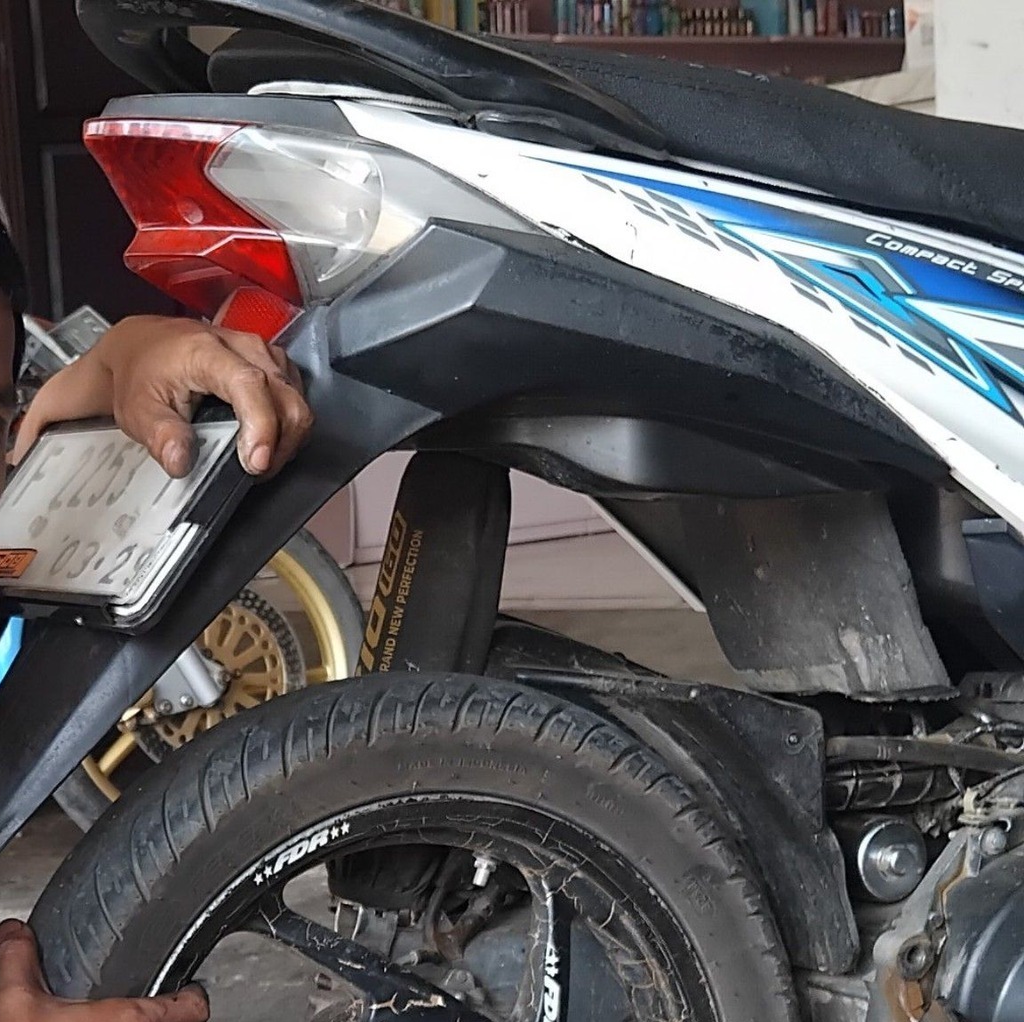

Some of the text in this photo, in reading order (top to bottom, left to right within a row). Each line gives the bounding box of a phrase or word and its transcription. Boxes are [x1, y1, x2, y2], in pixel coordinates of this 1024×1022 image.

[866, 232, 979, 275] Compact
[380, 529, 425, 674] RAND NEW PERFECTION
[273, 829, 330, 874] FDR
